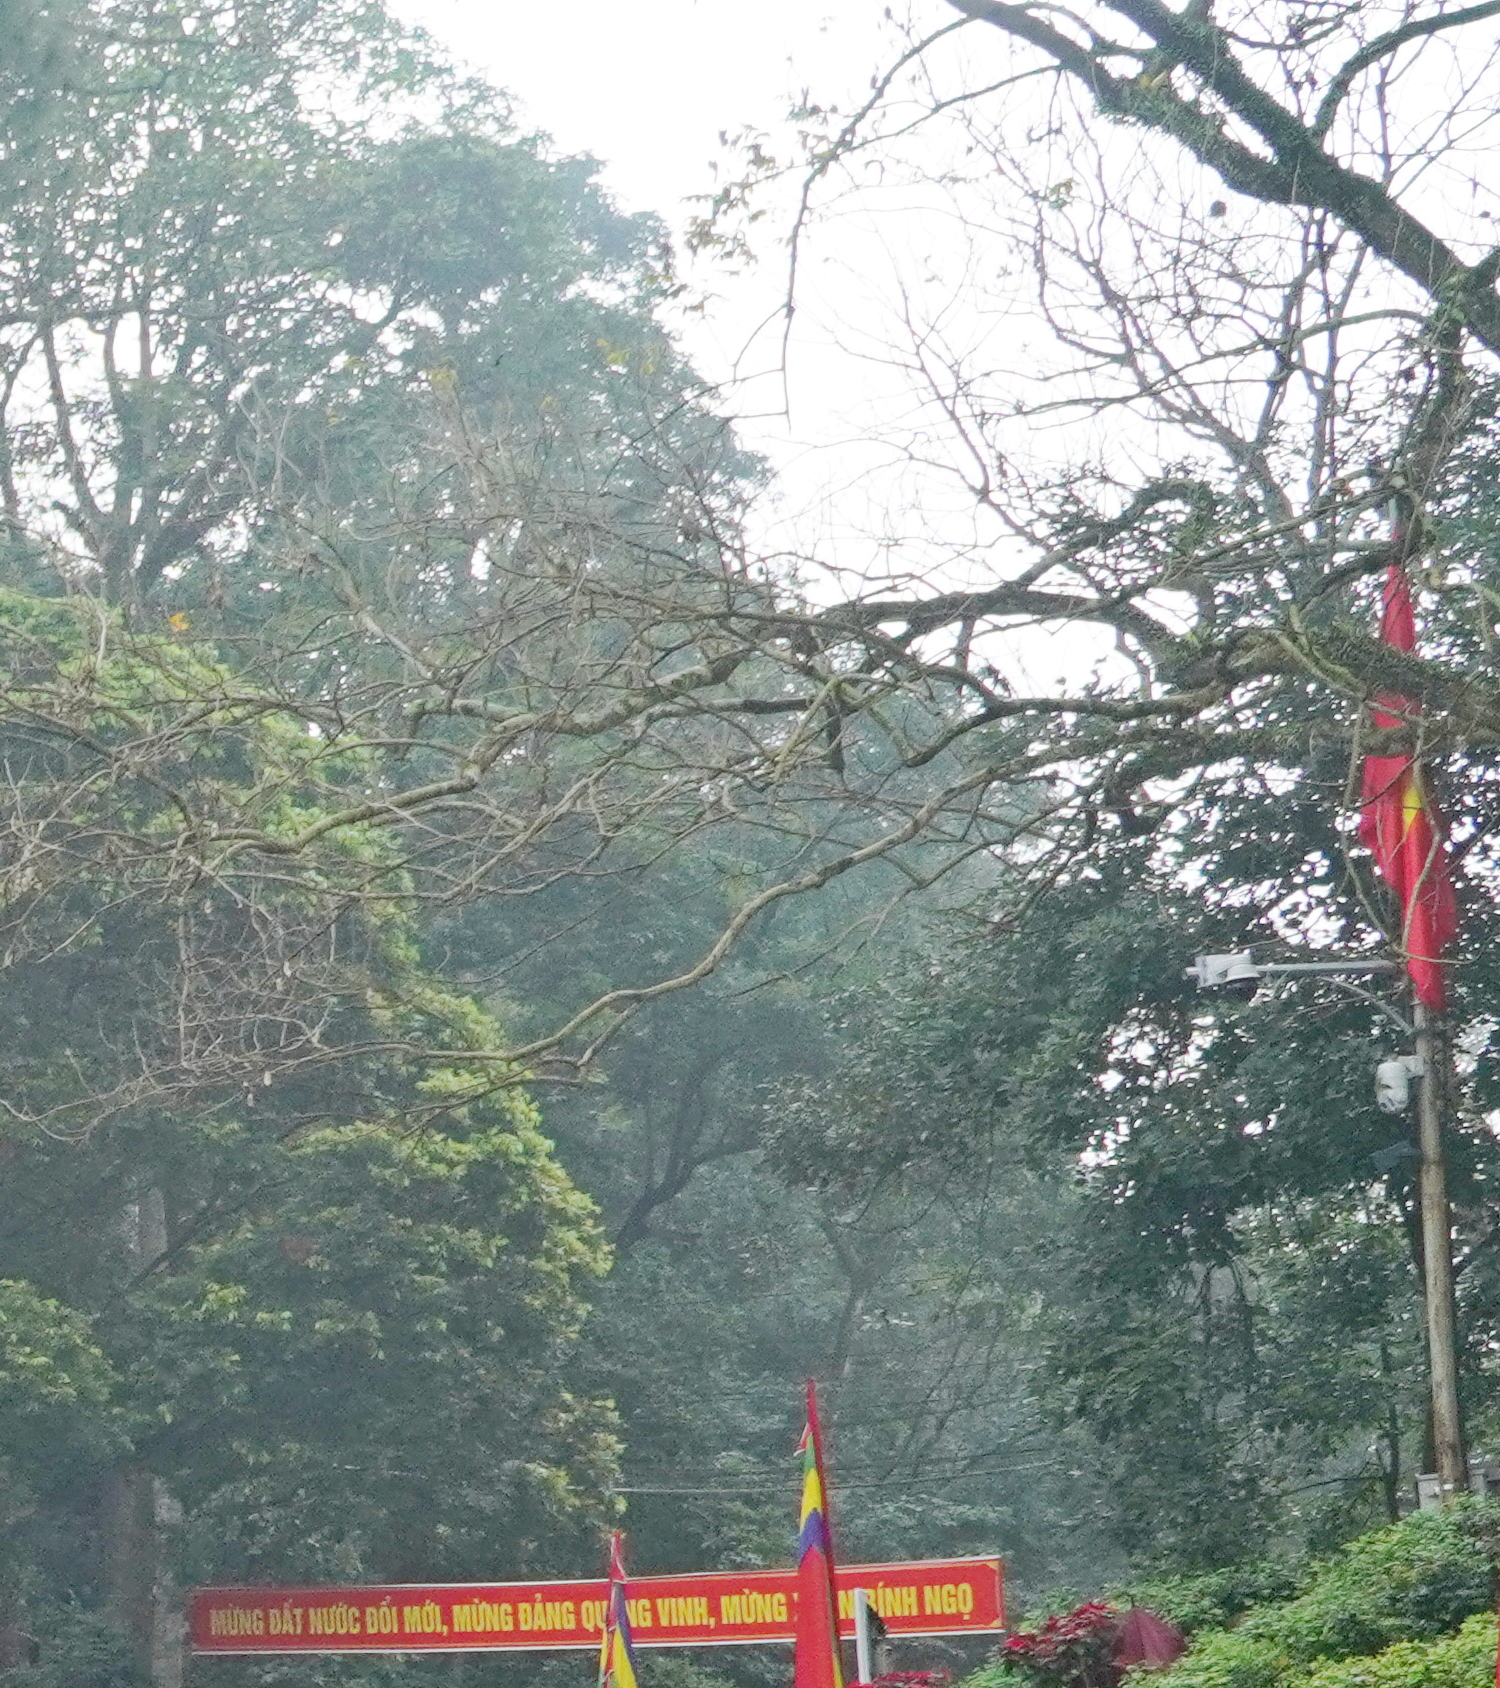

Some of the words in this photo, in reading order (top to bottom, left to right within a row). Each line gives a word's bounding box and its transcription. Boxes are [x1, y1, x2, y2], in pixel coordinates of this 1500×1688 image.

[308, 1601, 361, 1635] NƯỚC
[365, 1595, 398, 1634] ĐỔI
[403, 1599, 448, 1636] MỚI,
[452, 1597, 514, 1633] MỪNG
[518, 1593, 576, 1631] ĐẢNG
[581, 1598, 652, 1632] QUNG
[655, 1596, 716, 1629] VINH,
[720, 1588, 788, 1625] MỪNG
[923, 1582, 973, 1620] NGỌ
